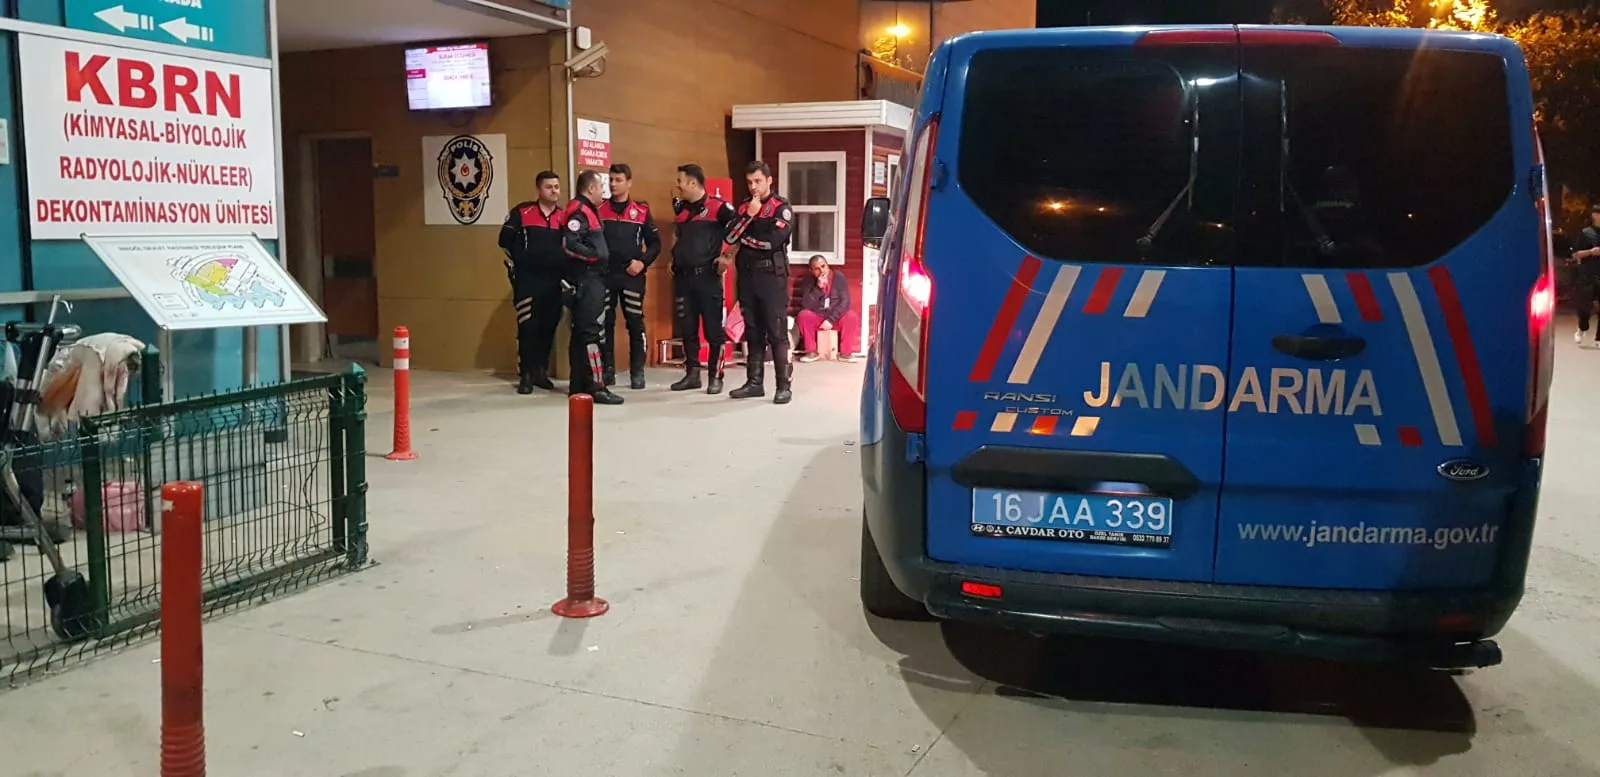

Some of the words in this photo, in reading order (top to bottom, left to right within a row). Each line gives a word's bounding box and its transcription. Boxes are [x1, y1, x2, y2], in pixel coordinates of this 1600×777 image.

[64, 50, 243, 119] KBRN
[63, 109, 247, 149] (KİMYASAL-BİYOLOJİK
[451, 140, 478, 152] POLİS
[59, 156, 253, 192] RADYOLOJİK-NÜKLEER)
[36, 197, 210, 224] DEKONTAMİNASYON
[216, 199, 273, 225] ÜNİTESİ
[1083, 361, 1383, 416] JANDARMA
[1006, 406, 1073, 416] CUSTOM
[1450, 464, 1479, 476] Ford
[992, 493, 1022, 521] 16
[1027, 496, 1095, 526] JAA
[1105, 499, 1166, 530] 339
[1006, 526, 1055, 537] CAVDAR
[1058, 529, 1084, 539] OTO
[1237, 520, 1498, 549] www.jandarma.gov.tr
